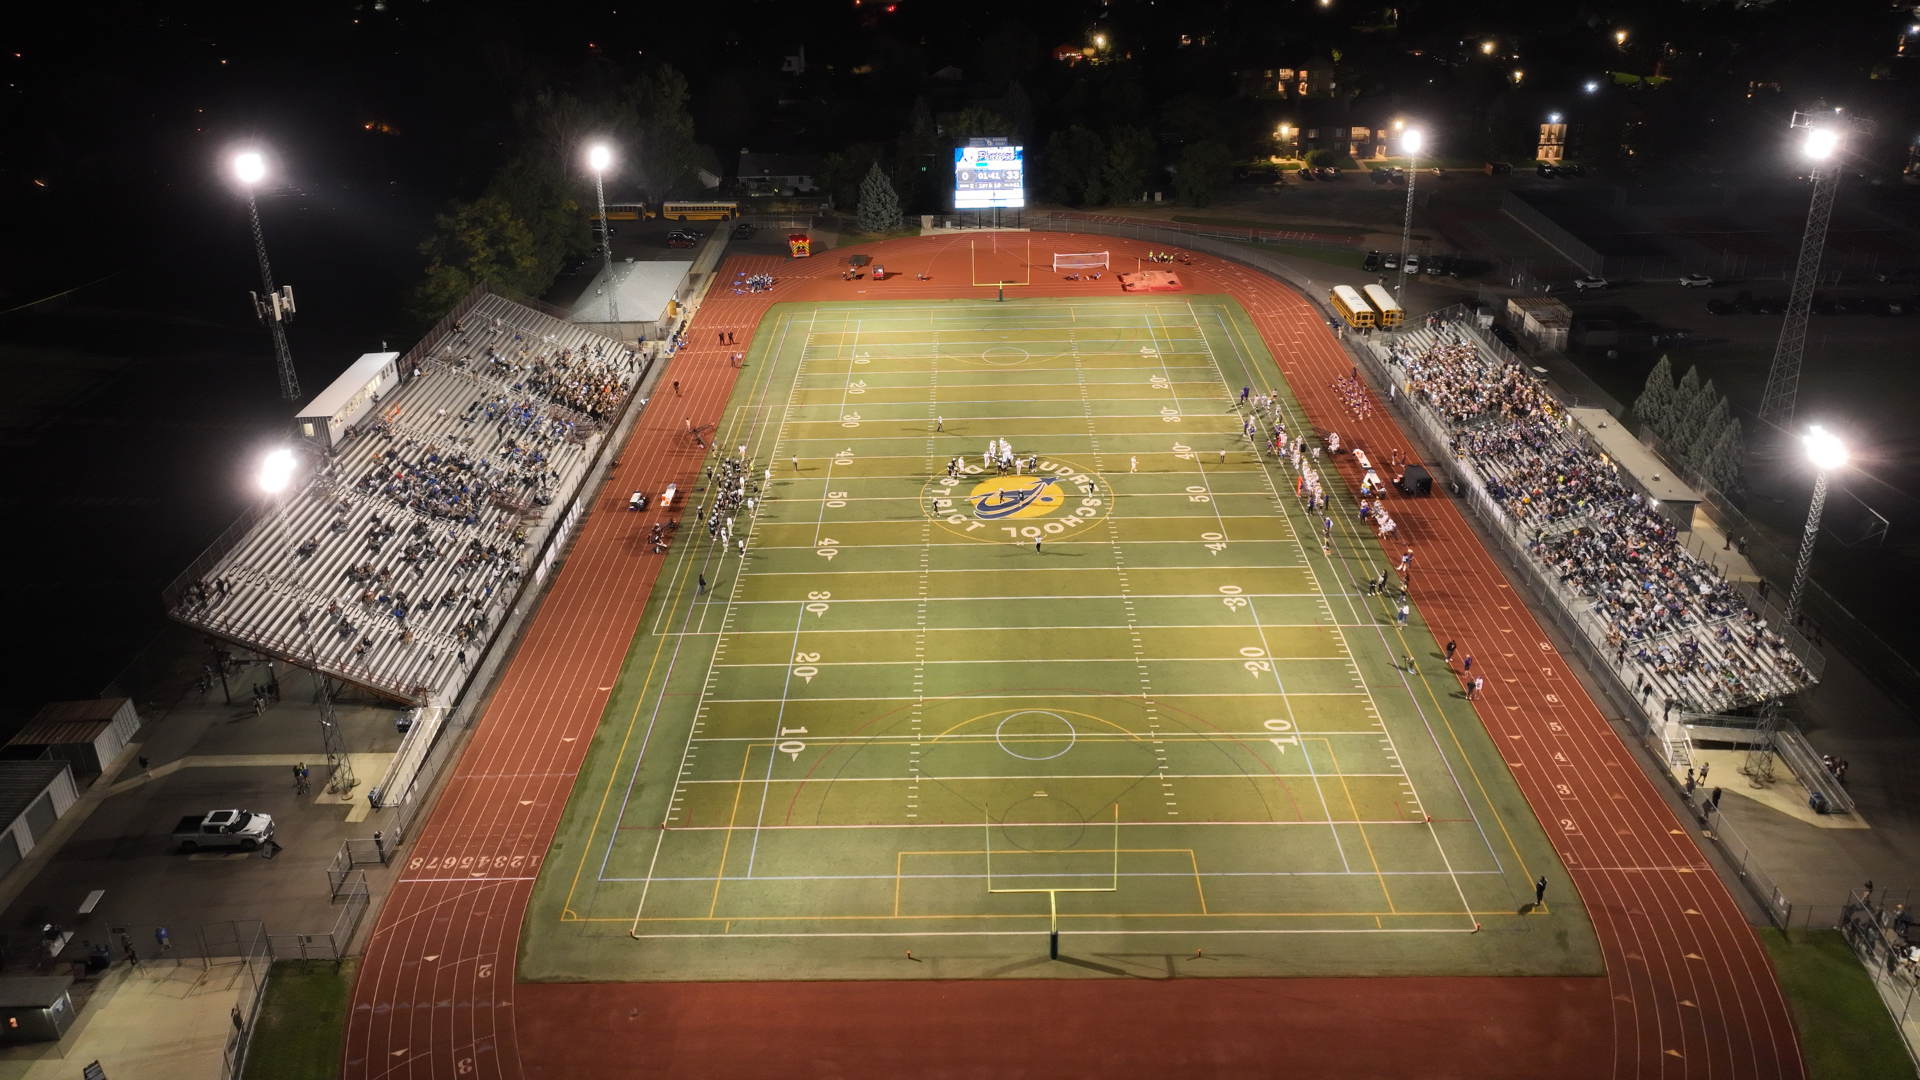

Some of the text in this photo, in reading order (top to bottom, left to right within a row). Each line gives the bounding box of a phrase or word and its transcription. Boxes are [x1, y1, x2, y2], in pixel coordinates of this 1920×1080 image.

[962, 172, 969, 180] 0
[1006, 171, 1019, 179] 33
[854, 354, 871, 364] 10
[1140, 348, 1159, 358] 10
[848, 382, 866, 394] 20
[1150, 378, 1169, 389] 20
[842, 414, 861, 427] 30
[1160, 410, 1181, 423] 30
[835, 450, 854, 465] 40
[1172, 445, 1194, 460] 40
[826, 492, 847, 508] 50
[1186, 486, 1210, 502] 50
[1002, 498, 1102, 538] SCHOOL
[817, 538, 839, 556] 40
[1201, 532, 1227, 551] 40
[806, 590, 831, 613] 30
[1219, 585, 1248, 607] 30
[1539, 642, 1551, 650] 8
[793, 652, 821, 679] 20
[1240, 646, 1271, 673] 20
[1542, 668, 1552, 676] 7
[1546, 694, 1558, 703] 6
[1264, 719, 1299, 747] 10
[1550, 722, 1562, 731] 5
[778, 726, 809, 754] 10
[1555, 752, 1567, 762] 4
[1557, 784, 1571, 795] 3
[1561, 819, 1576, 830] 2
[409, 857, 424, 870] 8
[425, 857, 438, 870] 7
[443, 857, 457, 869] 6
[460, 857, 474, 869] 5
[478, 856, 490, 869] 4
[494, 856, 507, 868] 3
[510, 856, 525, 868] 2
[529, 856, 540, 868] 1
[1564, 852, 1578, 864] 1
[478, 963, 492, 978] 2
[458, 1058, 472, 1074] 3
